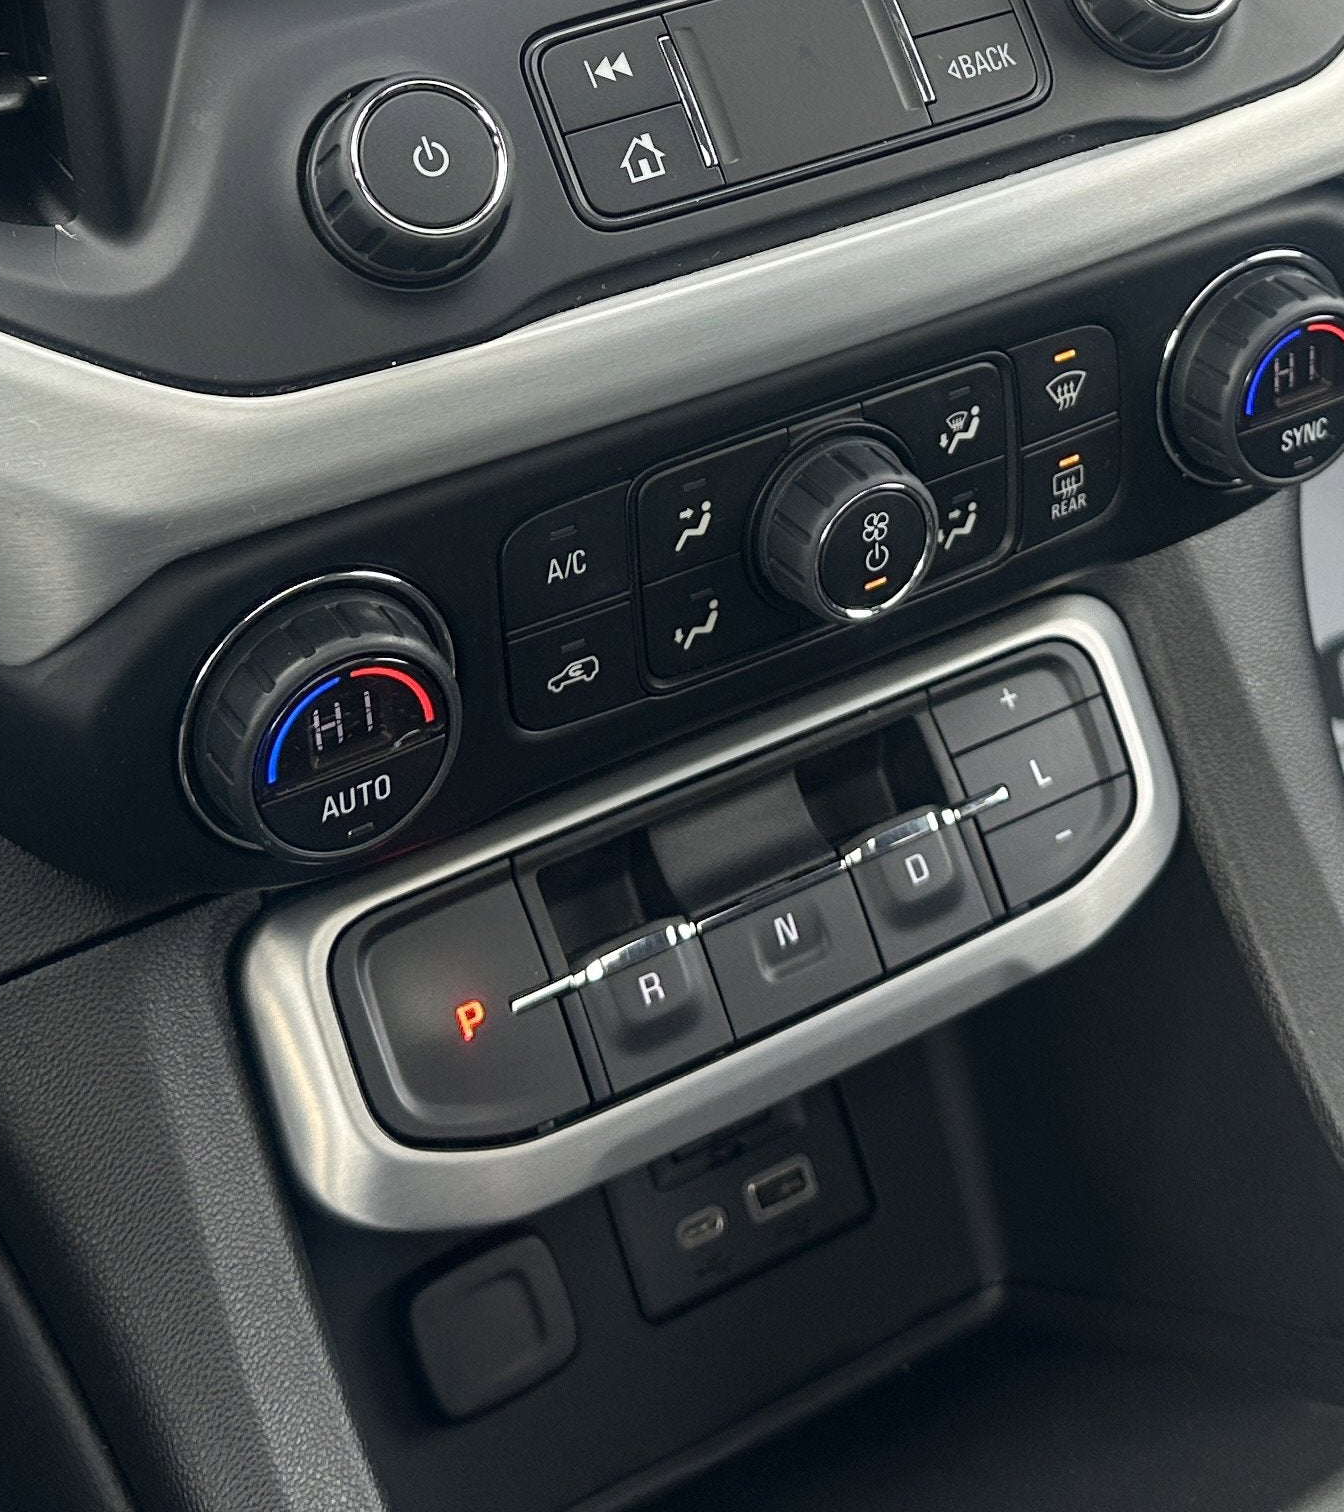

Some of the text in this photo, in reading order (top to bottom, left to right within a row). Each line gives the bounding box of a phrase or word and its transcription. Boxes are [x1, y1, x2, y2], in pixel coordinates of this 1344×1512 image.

[957, 42, 1017, 79] BACK
[1281, 416, 1329, 453] SYNC
[1051, 493, 1087, 520] REAR
[547, 549, 587, 584] A/C
[1030, 758, 1053, 787] L
[321, 774, 392, 823] AUTO
[906, 852, 932, 886] D
[774, 912, 802, 949] N
[637, 971, 667, 1006] R
[455, 998, 486, 1043] P
